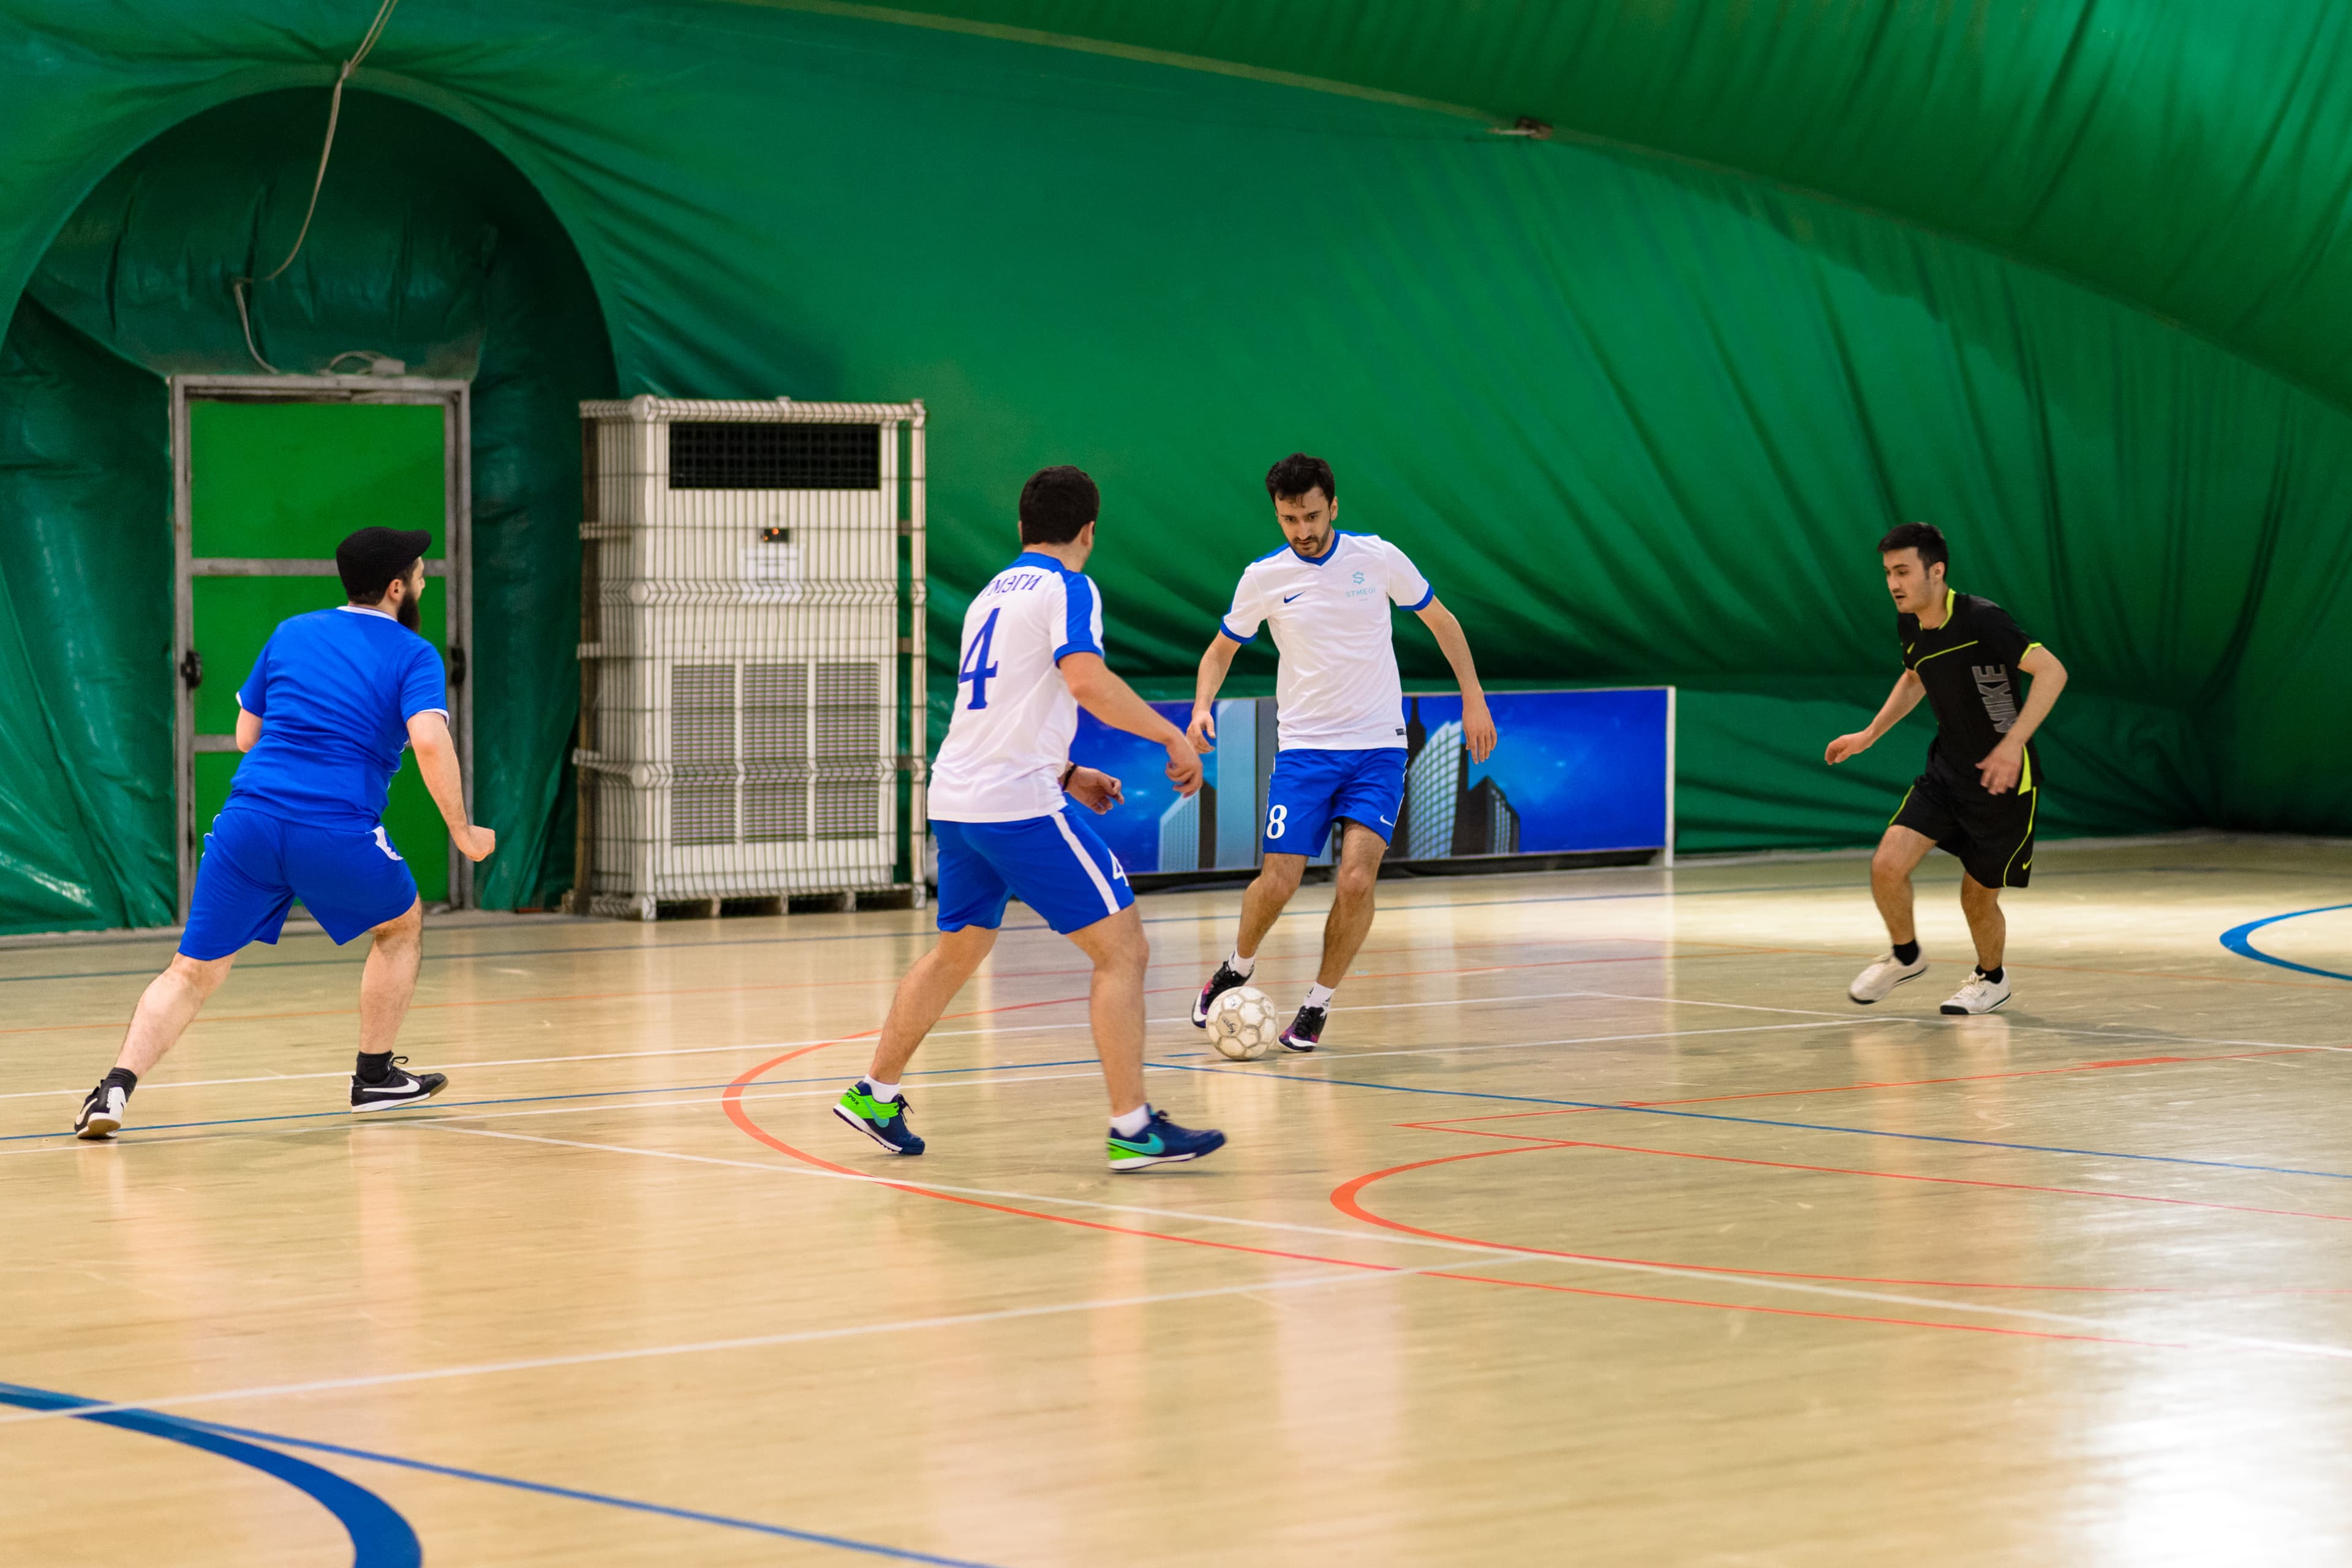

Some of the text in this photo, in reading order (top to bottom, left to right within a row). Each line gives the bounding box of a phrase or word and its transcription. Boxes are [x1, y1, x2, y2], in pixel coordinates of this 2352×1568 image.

[959, 607, 1001, 710] 4
[1972, 664, 2018, 733] NIKE
[1266, 804, 1287, 839] 8
[1107, 846, 1129, 887] 4
